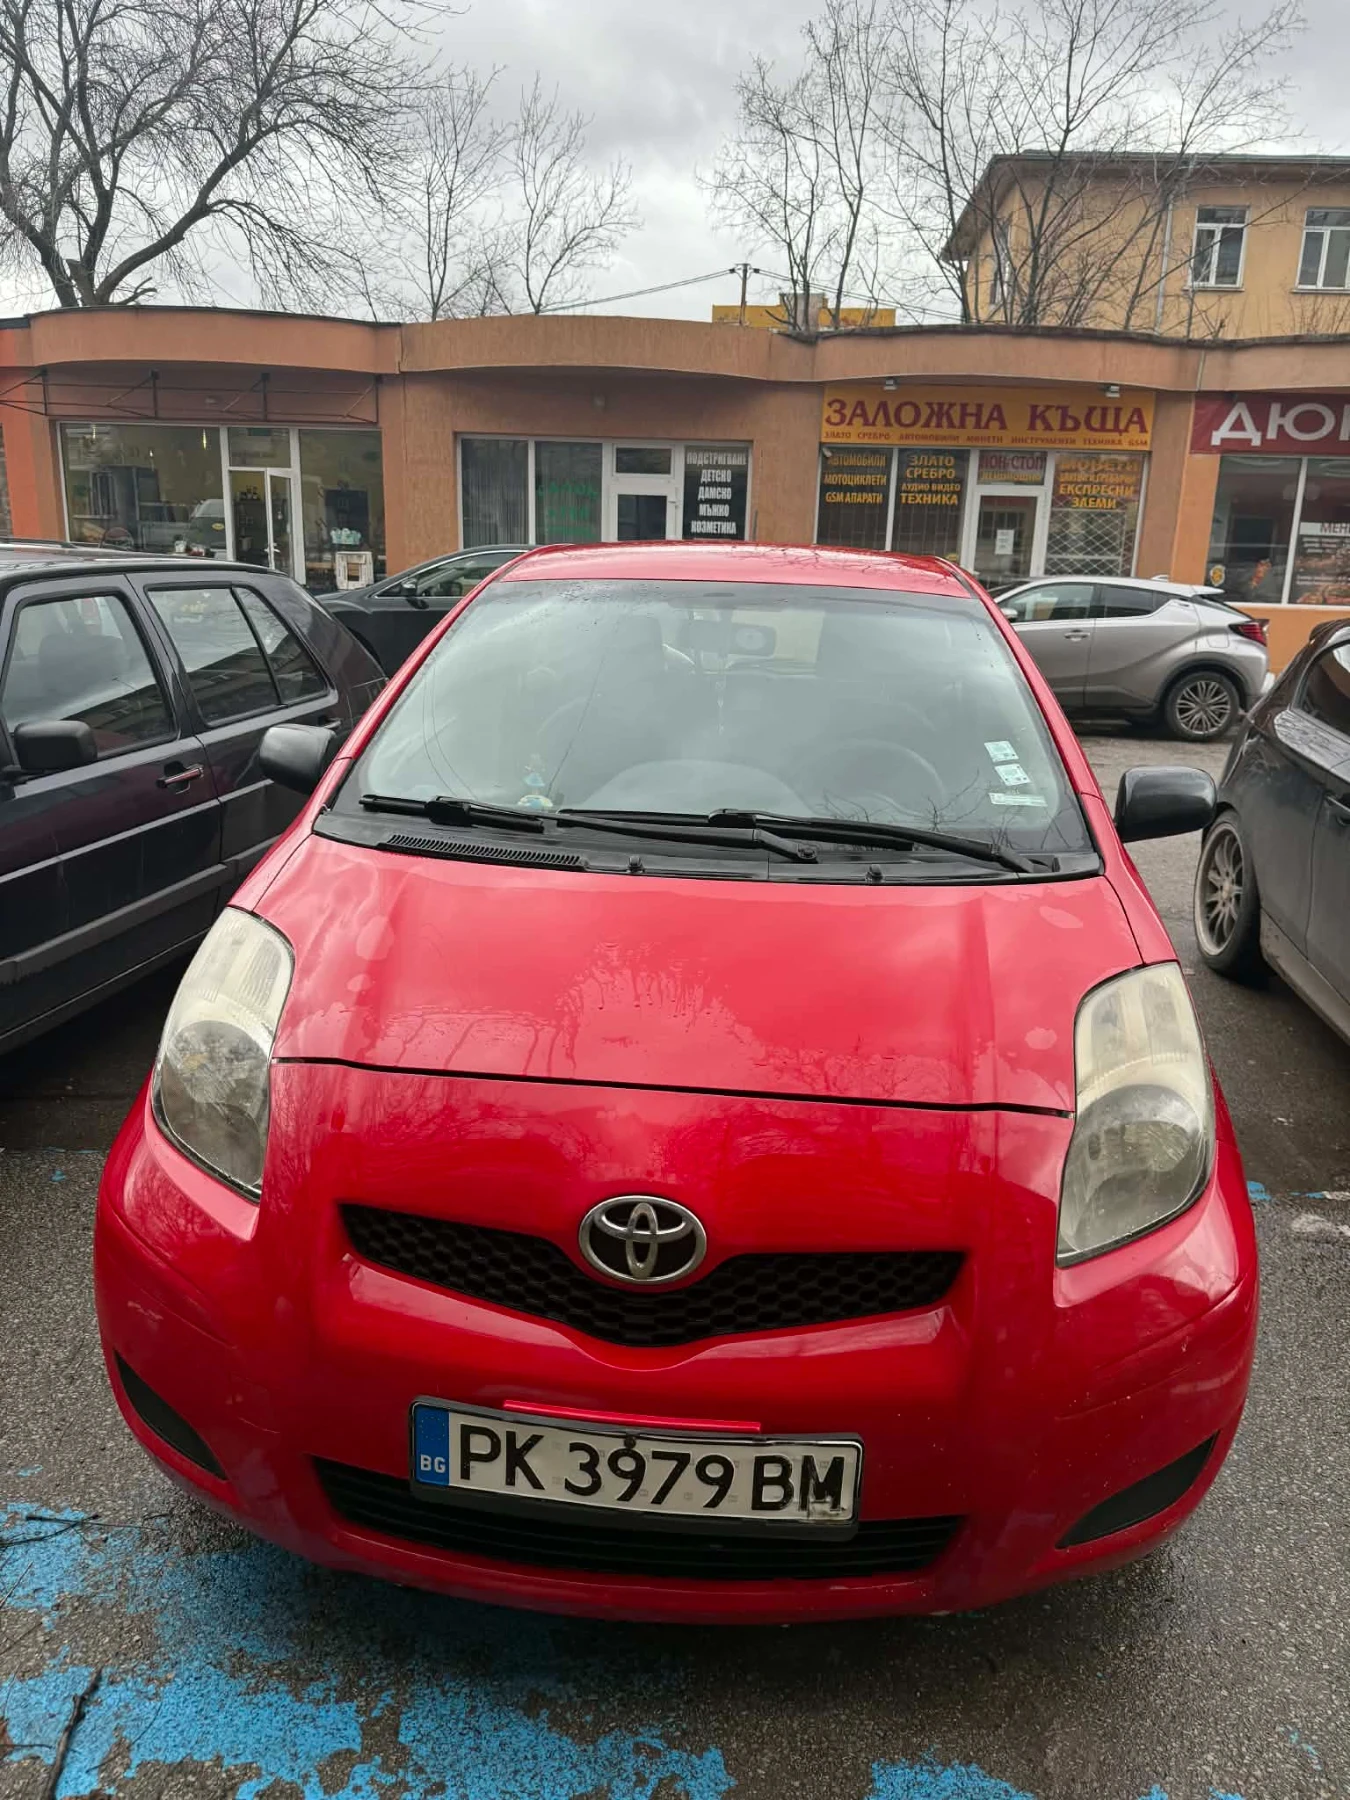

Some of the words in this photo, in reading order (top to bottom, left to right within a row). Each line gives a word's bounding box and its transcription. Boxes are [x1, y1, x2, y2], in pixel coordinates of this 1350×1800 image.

[826, 399, 1007, 430] ЗАЛОЖНА
[1026, 403, 1149, 436] КЪЩА
[1210, 401, 1350, 447] ДЮ
[824, 431, 852, 439] ЗЛАТО
[857, 431, 891, 440] СРЕБРО
[899, 433, 960, 442] АВТОМОБИЛИ
[686, 451, 747, 466] ПОДСТРИГВАНЕ
[908, 454, 955, 466] ЗЛАТО
[700, 469, 732, 484] ДЕТСКО
[824, 473, 887, 486] МОТОЦИКЛЕТИ
[906, 467, 956, 479] СРЕБРО
[697, 486, 732, 501] ДАМСКО
[901, 482, 930, 492] АУДИО
[931, 483, 961, 492] ВИДЕО
[1059, 484, 1134, 496] ЕКСПРЕСНИ
[825, 491, 844, 503] GSM
[845, 492, 883, 504] АПАРАТИ
[900, 493, 959, 505] ТЕХНИКА
[1071, 496, 1117, 508] ЗАЕМИ
[698, 503, 730, 517] МЪЖКО
[690, 520, 737, 534] КОЗМЕТИКА
[419, 1454, 446, 1474] BG
[459, 1423, 545, 1491] PK
[563, 1442, 736, 1508] 3979
[751, 1454, 846, 1512] BM
